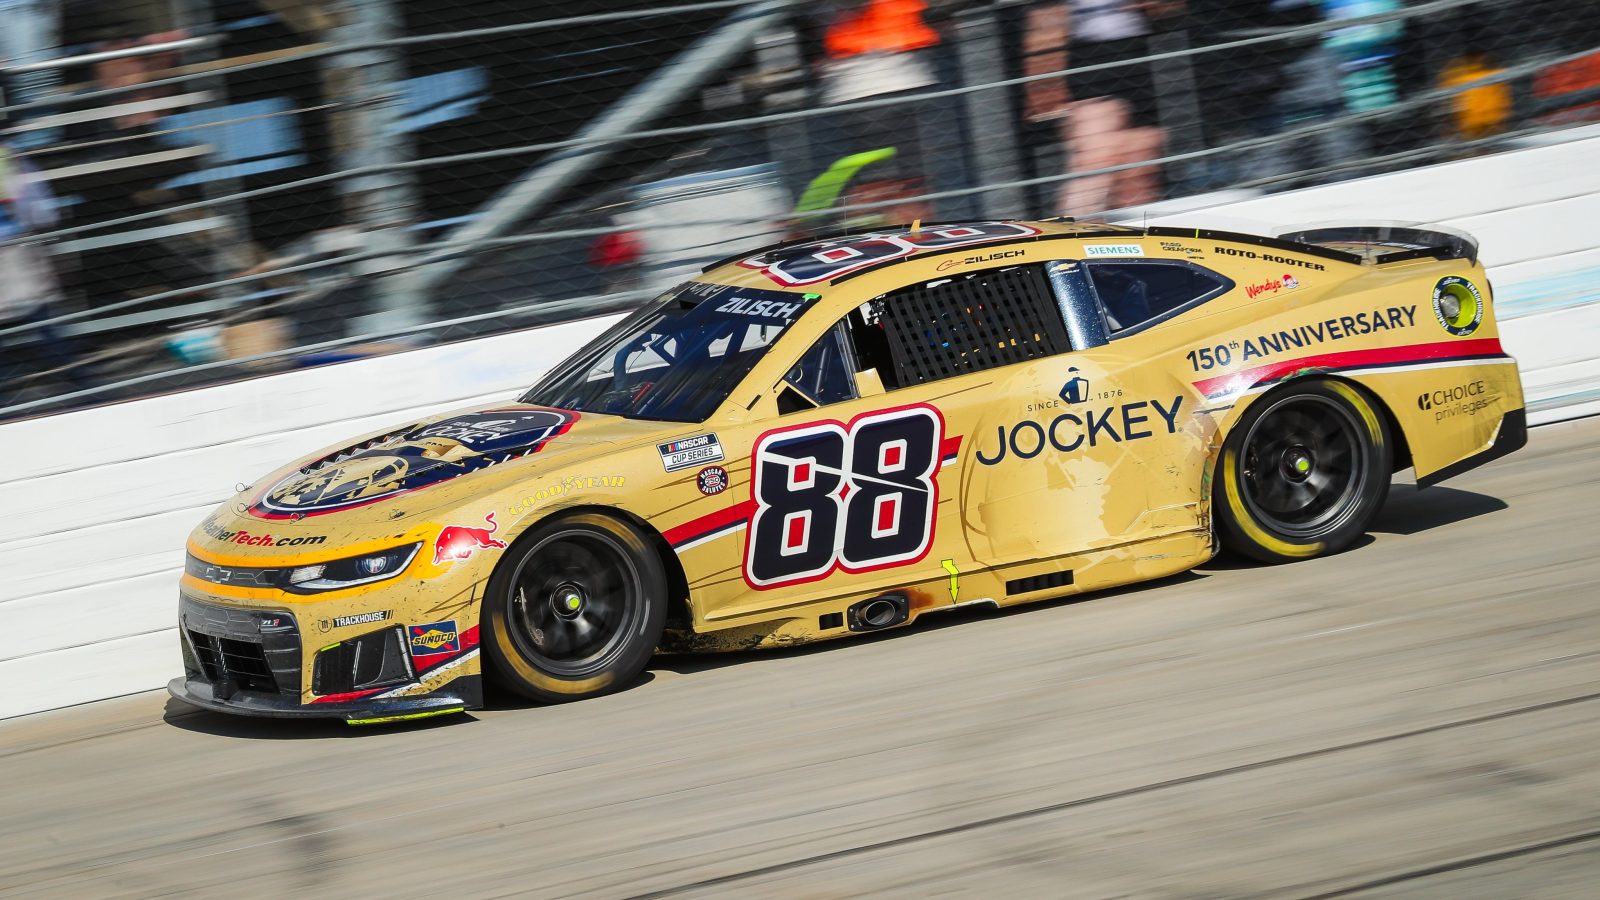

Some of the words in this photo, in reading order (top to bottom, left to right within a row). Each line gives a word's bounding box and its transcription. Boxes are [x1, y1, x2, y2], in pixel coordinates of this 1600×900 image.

[964, 249, 1026, 265] ZILISCH
[1087, 246, 1140, 255] SIEMENS
[1214, 246, 1325, 272] ROTO-ROOTER
[1245, 279, 1282, 299] Wendy's
[715, 297, 801, 318] ZILISCH
[1242, 305, 1417, 361] ANNIVERSARY
[1027, 400, 1059, 412] SINCE
[1097, 389, 1123, 399] 1876
[1432, 380, 1485, 406] CHOICE
[1435, 398, 1488, 423] privileges
[975, 395, 1184, 466] JOCKEY
[678, 436, 708, 450] NASCAR
[671, 454, 687, 464] CUP
[687, 447, 714, 460] SERIES
[700, 468, 723, 479] NASCAR
[508, 476, 626, 514] GOODYEAR
[701, 481, 726, 494] SALUTES
[742, 403, 945, 591] 88
[335, 612, 385, 627] TRACKHOUSE
[413, 631, 456, 646] SUNOCO
